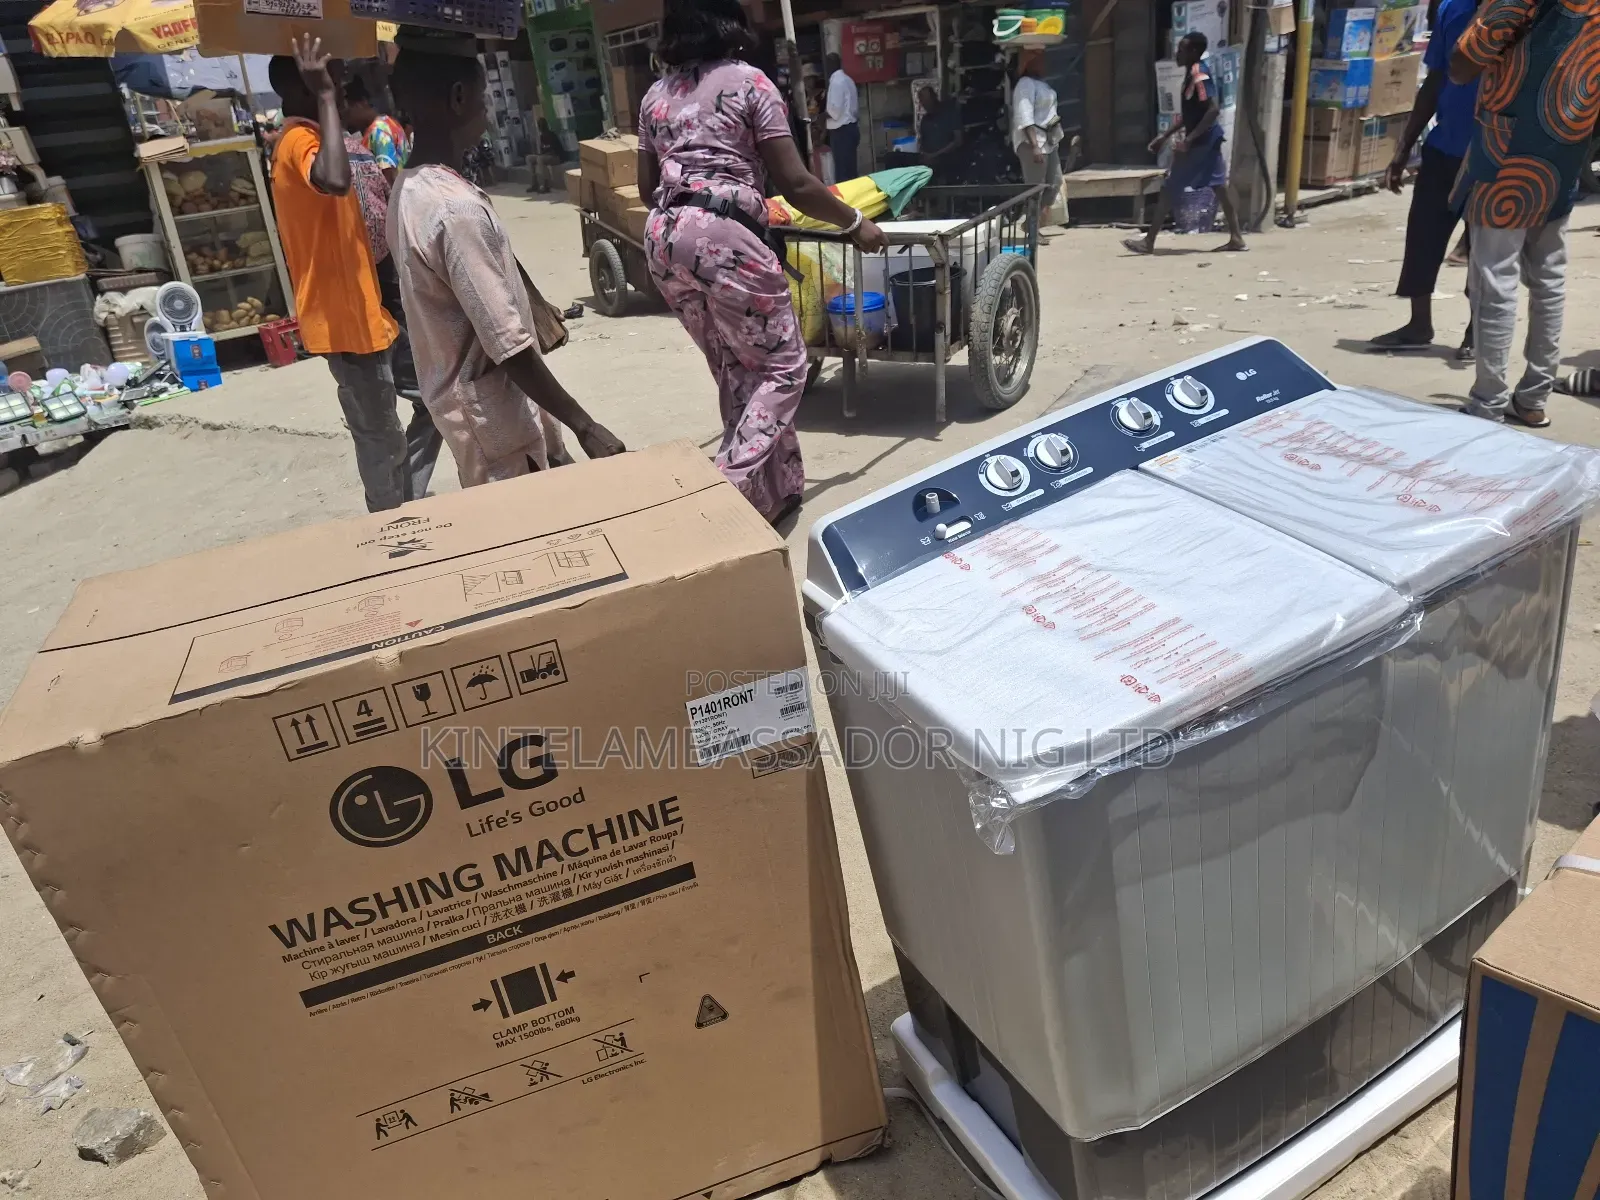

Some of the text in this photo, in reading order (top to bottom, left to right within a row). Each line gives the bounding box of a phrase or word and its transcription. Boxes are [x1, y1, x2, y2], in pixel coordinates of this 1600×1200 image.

[1244, 368, 1257, 377] LG
[377, 517, 430, 534] FRONT
[379, 532, 407, 541] step
[411, 527, 432, 535] not
[356, 539, 376, 549] on!
[371, 625, 445, 650] CAUTION
[356, 699, 373, 718] 4
[690, 688, 754, 720] P1401RONT
[444, 734, 559, 811] LG
[465, 786, 586, 838] Life's Good
[268, 795, 684, 949] WASHING MACHINE
[281, 945, 326, 963] Machine
[334, 933, 360, 947] laver
[370, 916, 417, 935] Lavadora
[426, 899, 471, 918] Lavatrice
[480, 870, 558, 900] Waschmaschine
[567, 853, 608, 872] Máquina
[609, 848, 621, 858] de
[622, 839, 647, 853] Lavar
[648, 829, 678, 844] Roupa
[301, 942, 375, 970] Стиральная
[376, 926, 425, 947] машина
[432, 914, 465, 929] Pralka
[471, 894, 523, 916] Пральна
[525, 878, 571, 899] машина
[593, 859, 624, 878] yuvish
[625, 843, 669, 869] mashinasi
[308, 970, 328, 981] Кір
[372, 940, 421, 961] машина
[429, 928, 460, 943] Mesin
[461, 919, 481, 932] cuci
[489, 902, 528, 923] 洗衣機
[486, 924, 523, 944] BACK
[492, 1006, 576, 1041] CLAMP BOTTOM
[495, 1015, 581, 1049] MAX 1500lbs, 680kg
[581, 1058, 647, 1085] LG Electronics Inc.
